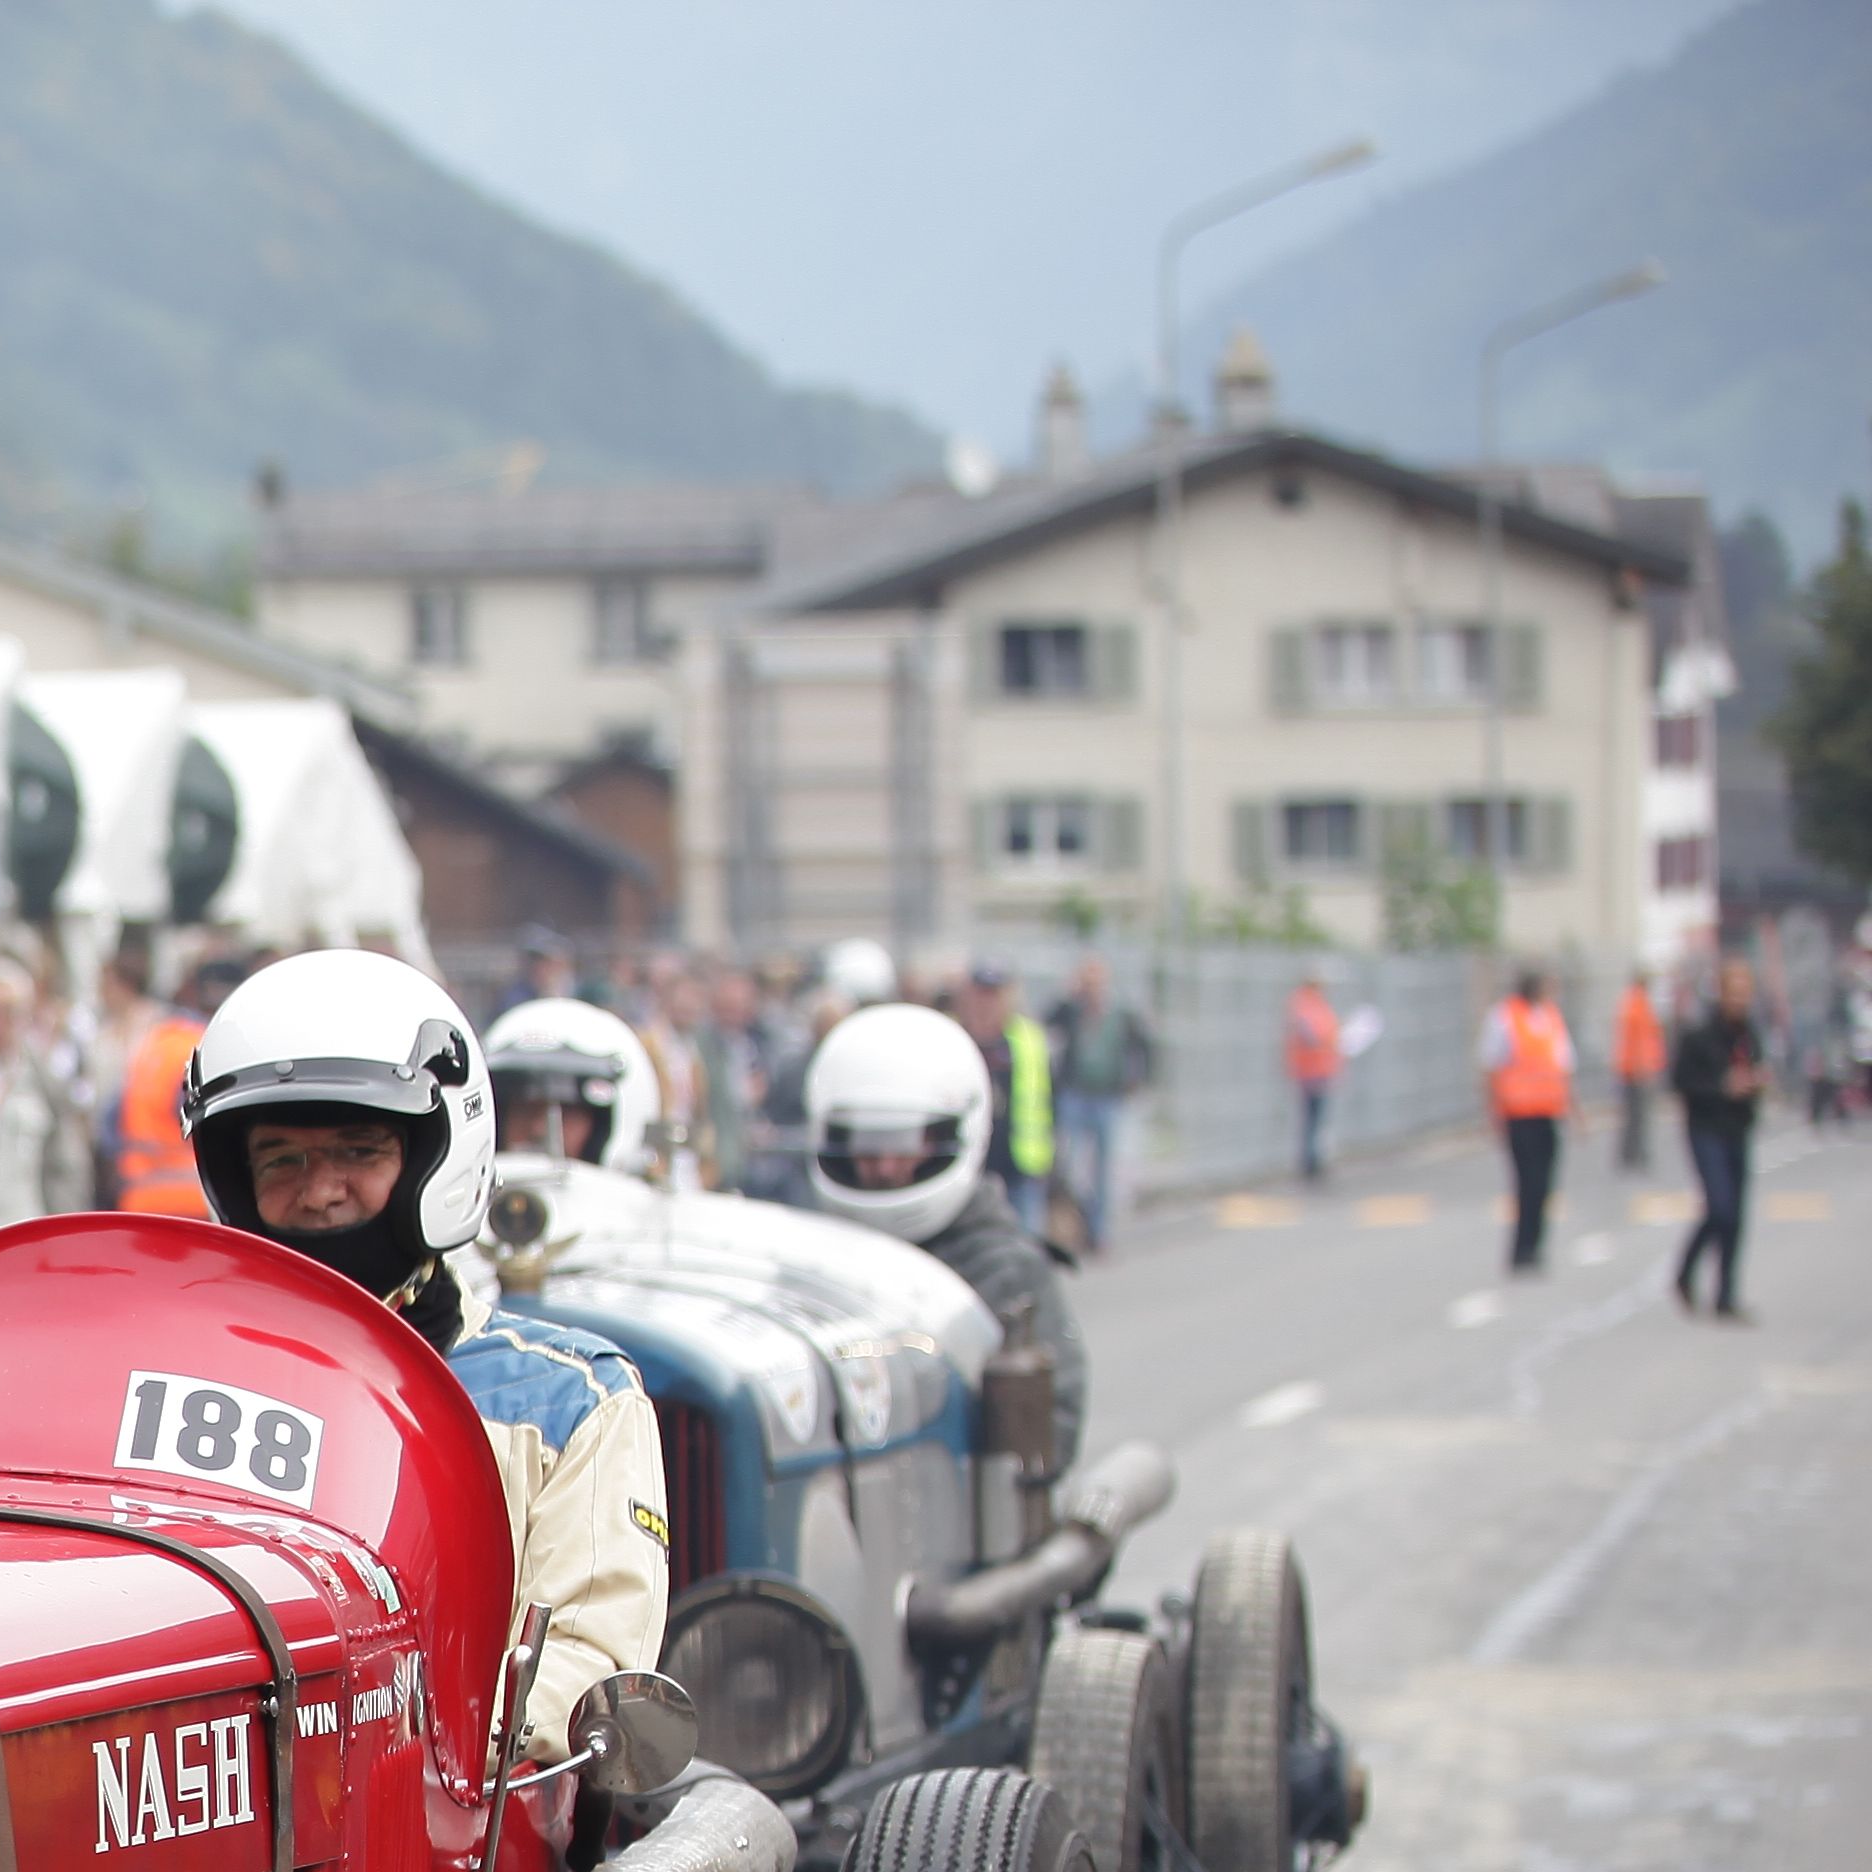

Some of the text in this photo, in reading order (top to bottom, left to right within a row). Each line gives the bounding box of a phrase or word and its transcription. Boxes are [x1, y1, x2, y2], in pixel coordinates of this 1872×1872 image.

[130, 1380, 312, 1492] 188
[351, 1684, 394, 1726] IGNITION
[92, 1713, 255, 1854] NASH
